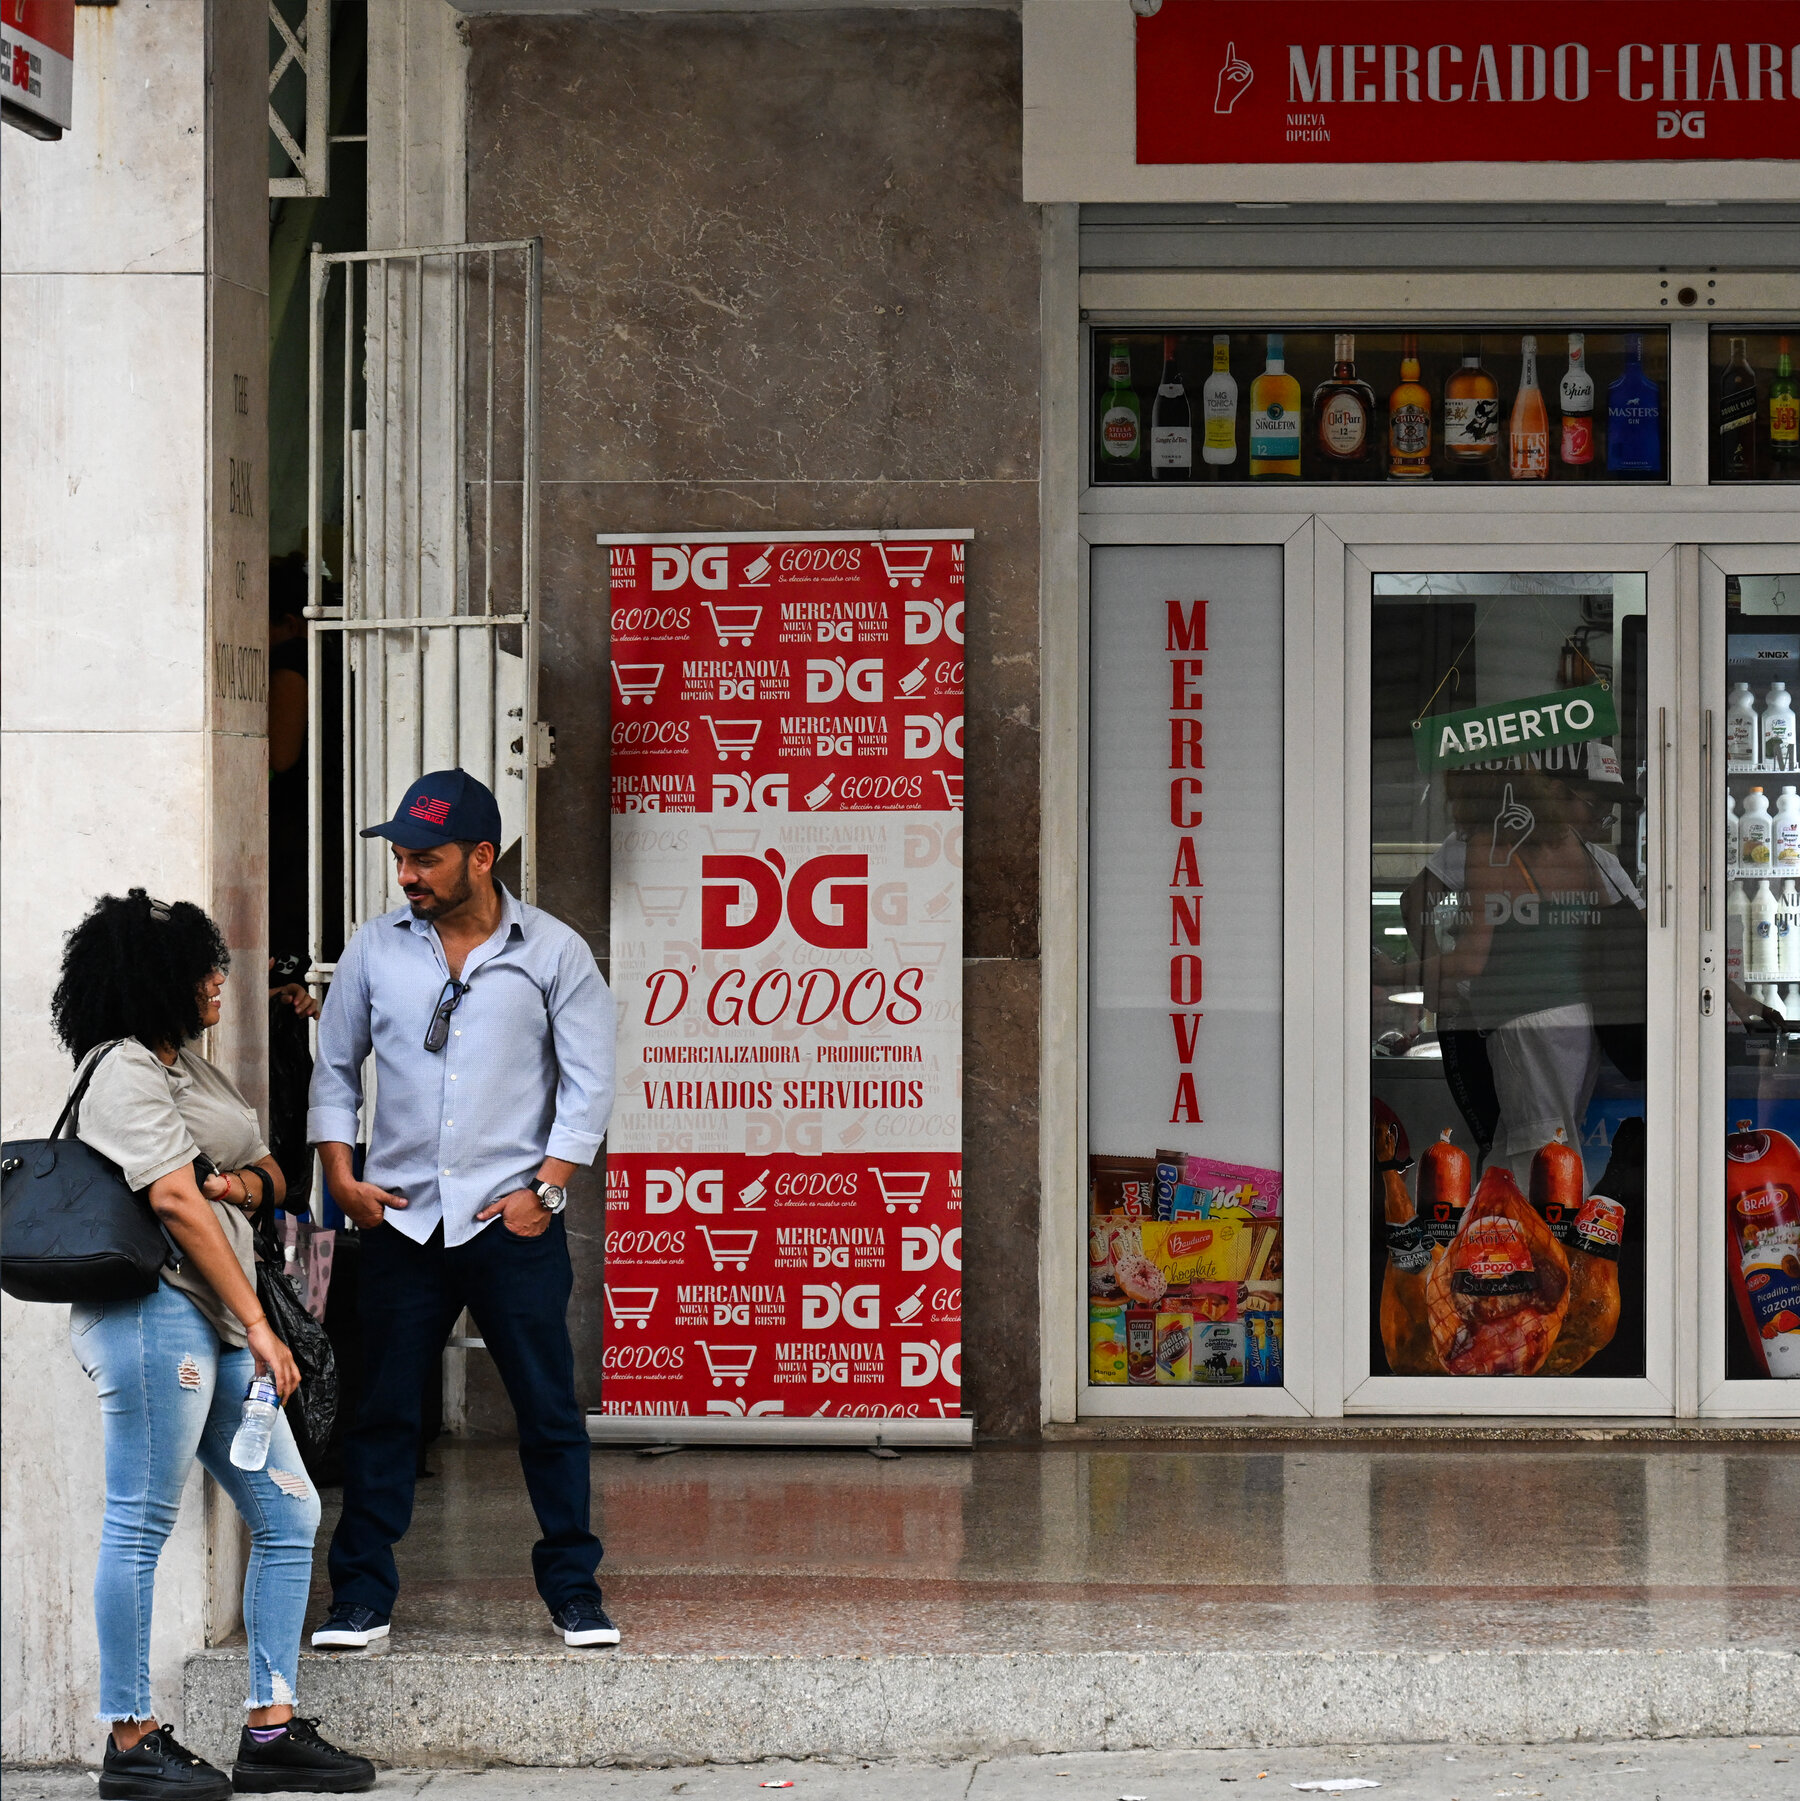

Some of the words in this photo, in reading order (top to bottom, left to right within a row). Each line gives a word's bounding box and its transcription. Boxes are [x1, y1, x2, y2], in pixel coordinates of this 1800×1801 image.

[1286, 42, 1800, 103] MERCADO-CHAR
[1286, 113, 1326, 126] NUEVA
[1286, 127, 1331, 143] OPCIÓN
[233, 374, 249, 416] THE
[1328, 411, 1343, 425] Old
[1395, 415, 1426, 424] CHIVAS
[1608, 407, 1660, 417] MASTER'S
[1255, 419, 1296, 430] SINGLETON
[1257, 445, 1268, 456] 12
[229, 458, 254, 518] BANK
[780, 548, 860, 570] GODOS
[611, 607, 690, 630] GODOS
[781, 602, 888, 619] MERCANOVA
[784, 622, 811, 630] NUEVA
[859, 621, 887, 629] NUEVO
[780, 632, 811, 642] OPCIÓN
[859, 633, 888, 641] GUSTO
[1757, 651, 1789, 659] XINGX
[683, 660, 790, 677] MERCANOVA
[686, 680, 713, 688] NUEVA
[761, 680, 789, 688] NUEVO
[681, 690, 713, 700] OPCIÓN
[760, 691, 790, 699] GUSTO
[612, 721, 689, 743] GODOS
[781, 716, 888, 734] MERCANOVA
[1438, 699, 1595, 758] ABIERTO
[783, 736, 811, 744] NUEVA
[858, 736, 886, 744] NUEVO
[779, 746, 811, 756] OPCIÓN
[858, 747, 887, 755] GUSTO
[841, 776, 922, 798] GODOS
[666, 794, 694, 802] NUEVO
[424, 814, 445, 826] MAGA
[1164, 600, 1209, 1123] MERCANOVA
[1549, 910, 1602, 926] GUSTO
[643, 1046, 800, 1064] COMERCIALIZADORA
[817, 1045, 923, 1063] PRODUCTORA
[643, 1080, 773, 1110] VARIADOS
[783, 1079, 924, 1109] SERVICIOS
[775, 1173, 857, 1195] GODOS
[1743, 1191, 1783, 1213] BRAVO
[604, 1230, 685, 1253] GODOS
[777, 1228, 885, 1244] MERCANOVA
[1169, 1232, 1211, 1254] Bauducco
[780, 1247, 807, 1256] NUEVA
[855, 1247, 884, 1255] NUEVO
[1399, 1252, 1423, 1262] GRAN
[775, 1257, 807, 1267] OPCIÓN
[855, 1259, 885, 1267] GUSTO
[1163, 1256, 1217, 1283] Chocolate
[677, 1286, 785, 1302] MERCANOVA
[1757, 1287, 1789, 1303] Picadillo
[680, 1305, 708, 1313] NUEVA
[756, 1305, 784, 1313] NUEVO
[676, 1315, 708, 1325] OPCIÓN
[755, 1317, 785, 1325] GUSTO
[1160, 1332, 1183, 1351] malta
[1160, 1336, 1191, 1361] morena
[602, 1345, 684, 1369] GODOS
[776, 1343, 884, 1360] MERCANOVA
[779, 1363, 806, 1371] NUEVA
[854, 1363, 883, 1371] NUEVO
[774, 1373, 806, 1383] OPCIÓN
[854, 1375, 884, 1383] GUSTO
